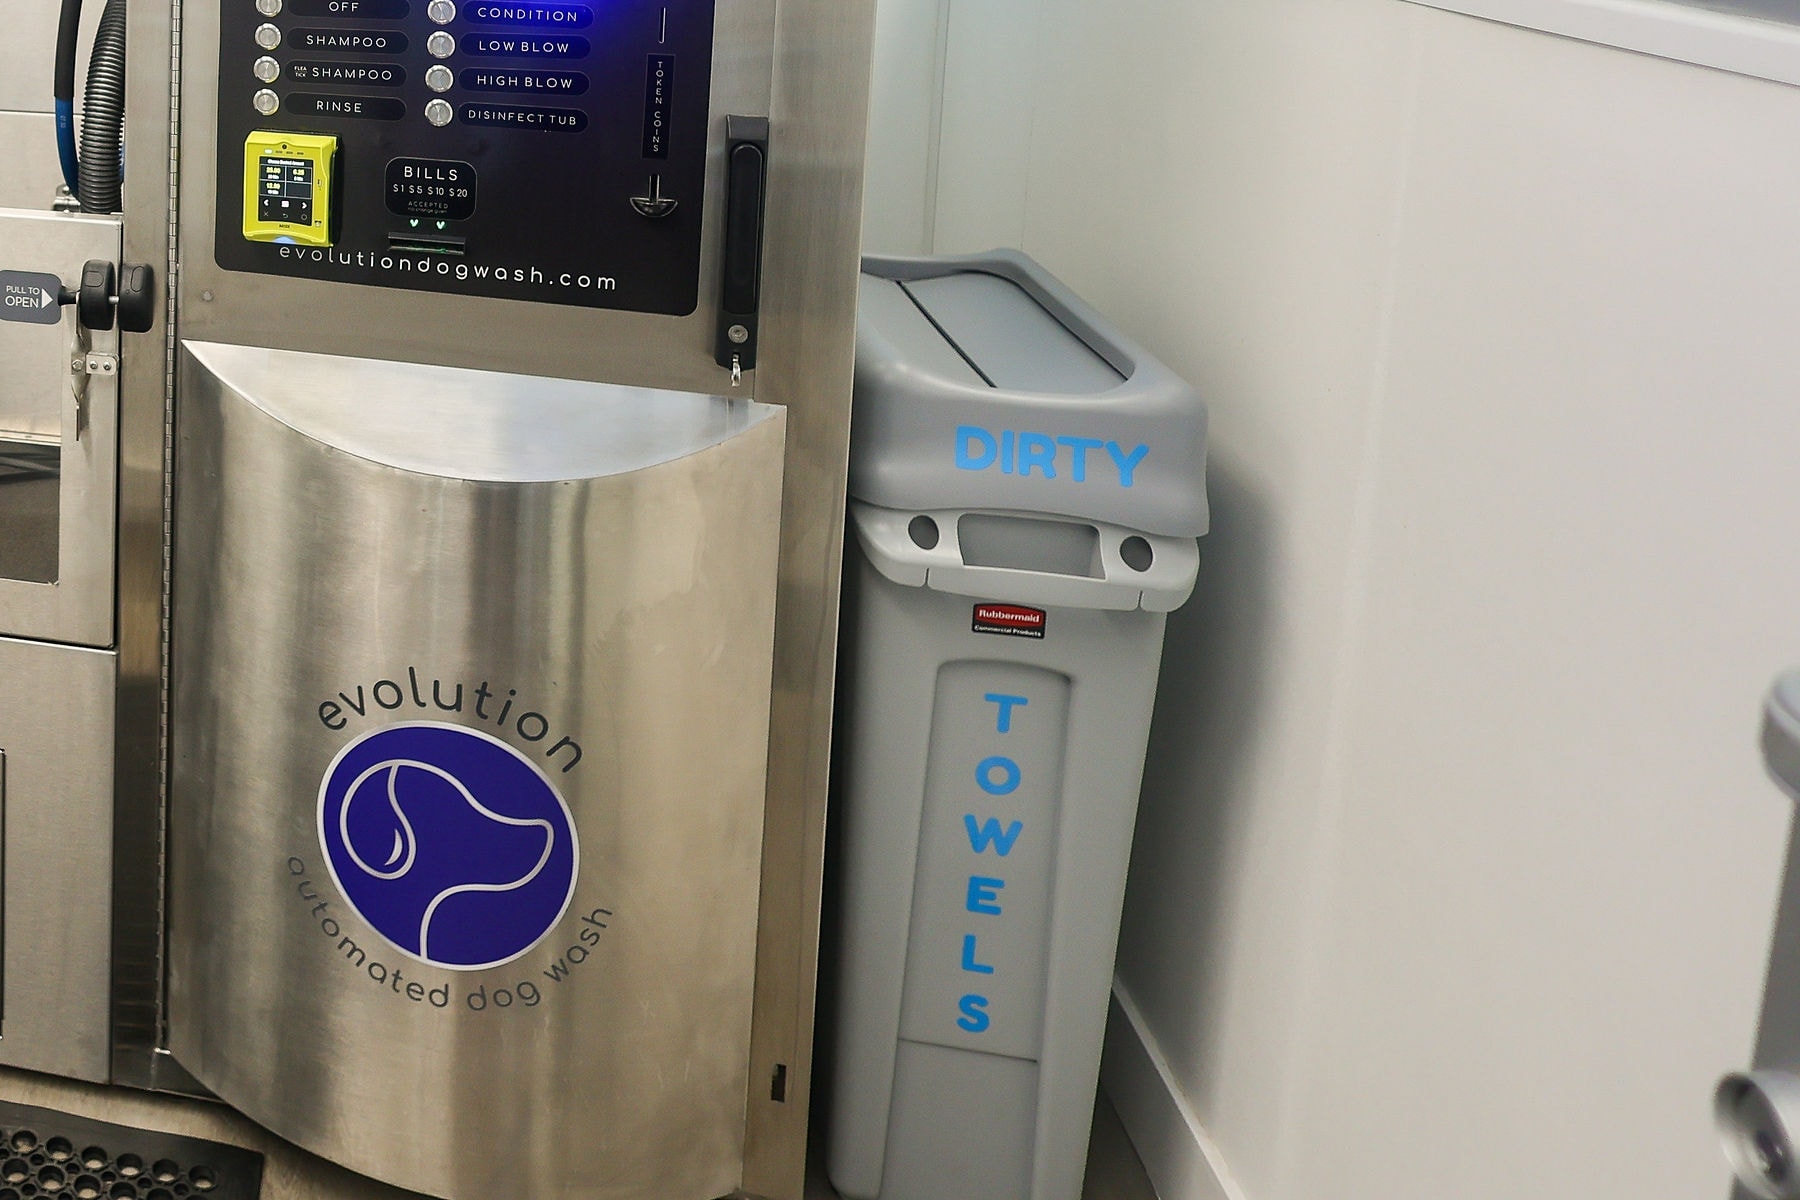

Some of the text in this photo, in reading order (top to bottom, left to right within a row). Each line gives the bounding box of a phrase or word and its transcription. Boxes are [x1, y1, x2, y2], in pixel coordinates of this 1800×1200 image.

[328, 1, 359, 13] OFF
[477, 7, 577, 22] CONDITION
[306, 34, 387, 48] SHAMPOO
[479, 40, 569, 53] LOW BLOW
[311, 67, 392, 81] SHAMPOO
[477, 75, 572, 89] HIGH BLOW
[316, 100, 362, 113] RINSE
[652, 61, 664, 152] TOKEN COINS
[468, 109, 577, 126] DISINFECT TUB
[404, 166, 458, 181] BILLS
[408, 201, 449, 209] ACCEPTED
[278, 246, 618, 292] evolutiondogwash.com
[5, 285, 40, 295] PULL TO
[5, 295, 39, 309] OPEN
[954, 425, 1150, 487] DIRTY
[979, 609, 1040, 623] Rubbermaid
[318, 666, 583, 773] evolution
[957, 692, 1028, 1033] TOWELS
[287, 855, 613, 1011] automated dog wash
